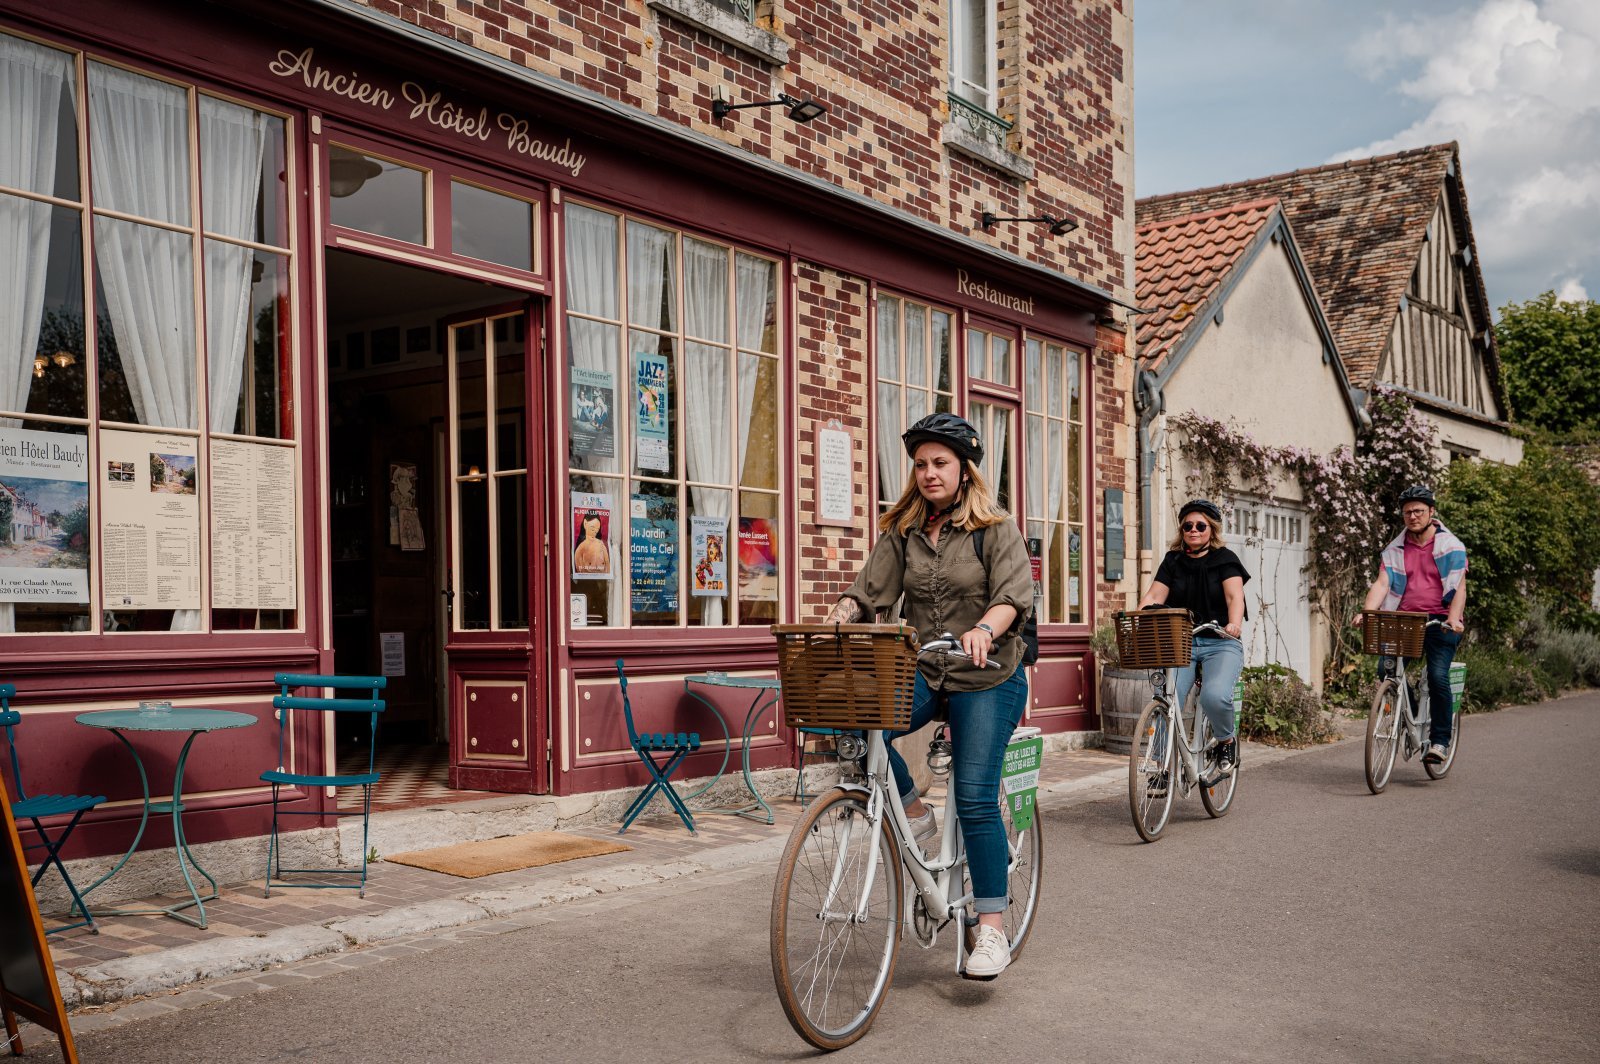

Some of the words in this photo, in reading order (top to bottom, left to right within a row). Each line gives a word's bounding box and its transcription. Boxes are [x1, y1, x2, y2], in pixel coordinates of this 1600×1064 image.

[268, 47, 394, 109] Ancien
[401, 81, 491, 140] Hôtel
[497, 113, 586, 177] Baudy
[957, 268, 1035, 316] Restaurant
[0, 438, 17, 457] ien
[21, 440, 49, 460] Hôtel
[53, 443, 85, 468] Baudy
[630, 527, 640, 537] Un
[641, 527, 666, 539] Jardin
[630, 542, 649, 553] dans
[650, 543, 657, 554] le
[658, 543, 674, 555] Ciel
[50, 579, 73, 587] Monet
[13, 587, 50, 595] GIVERNY
[56, 588, 78, 596] France
